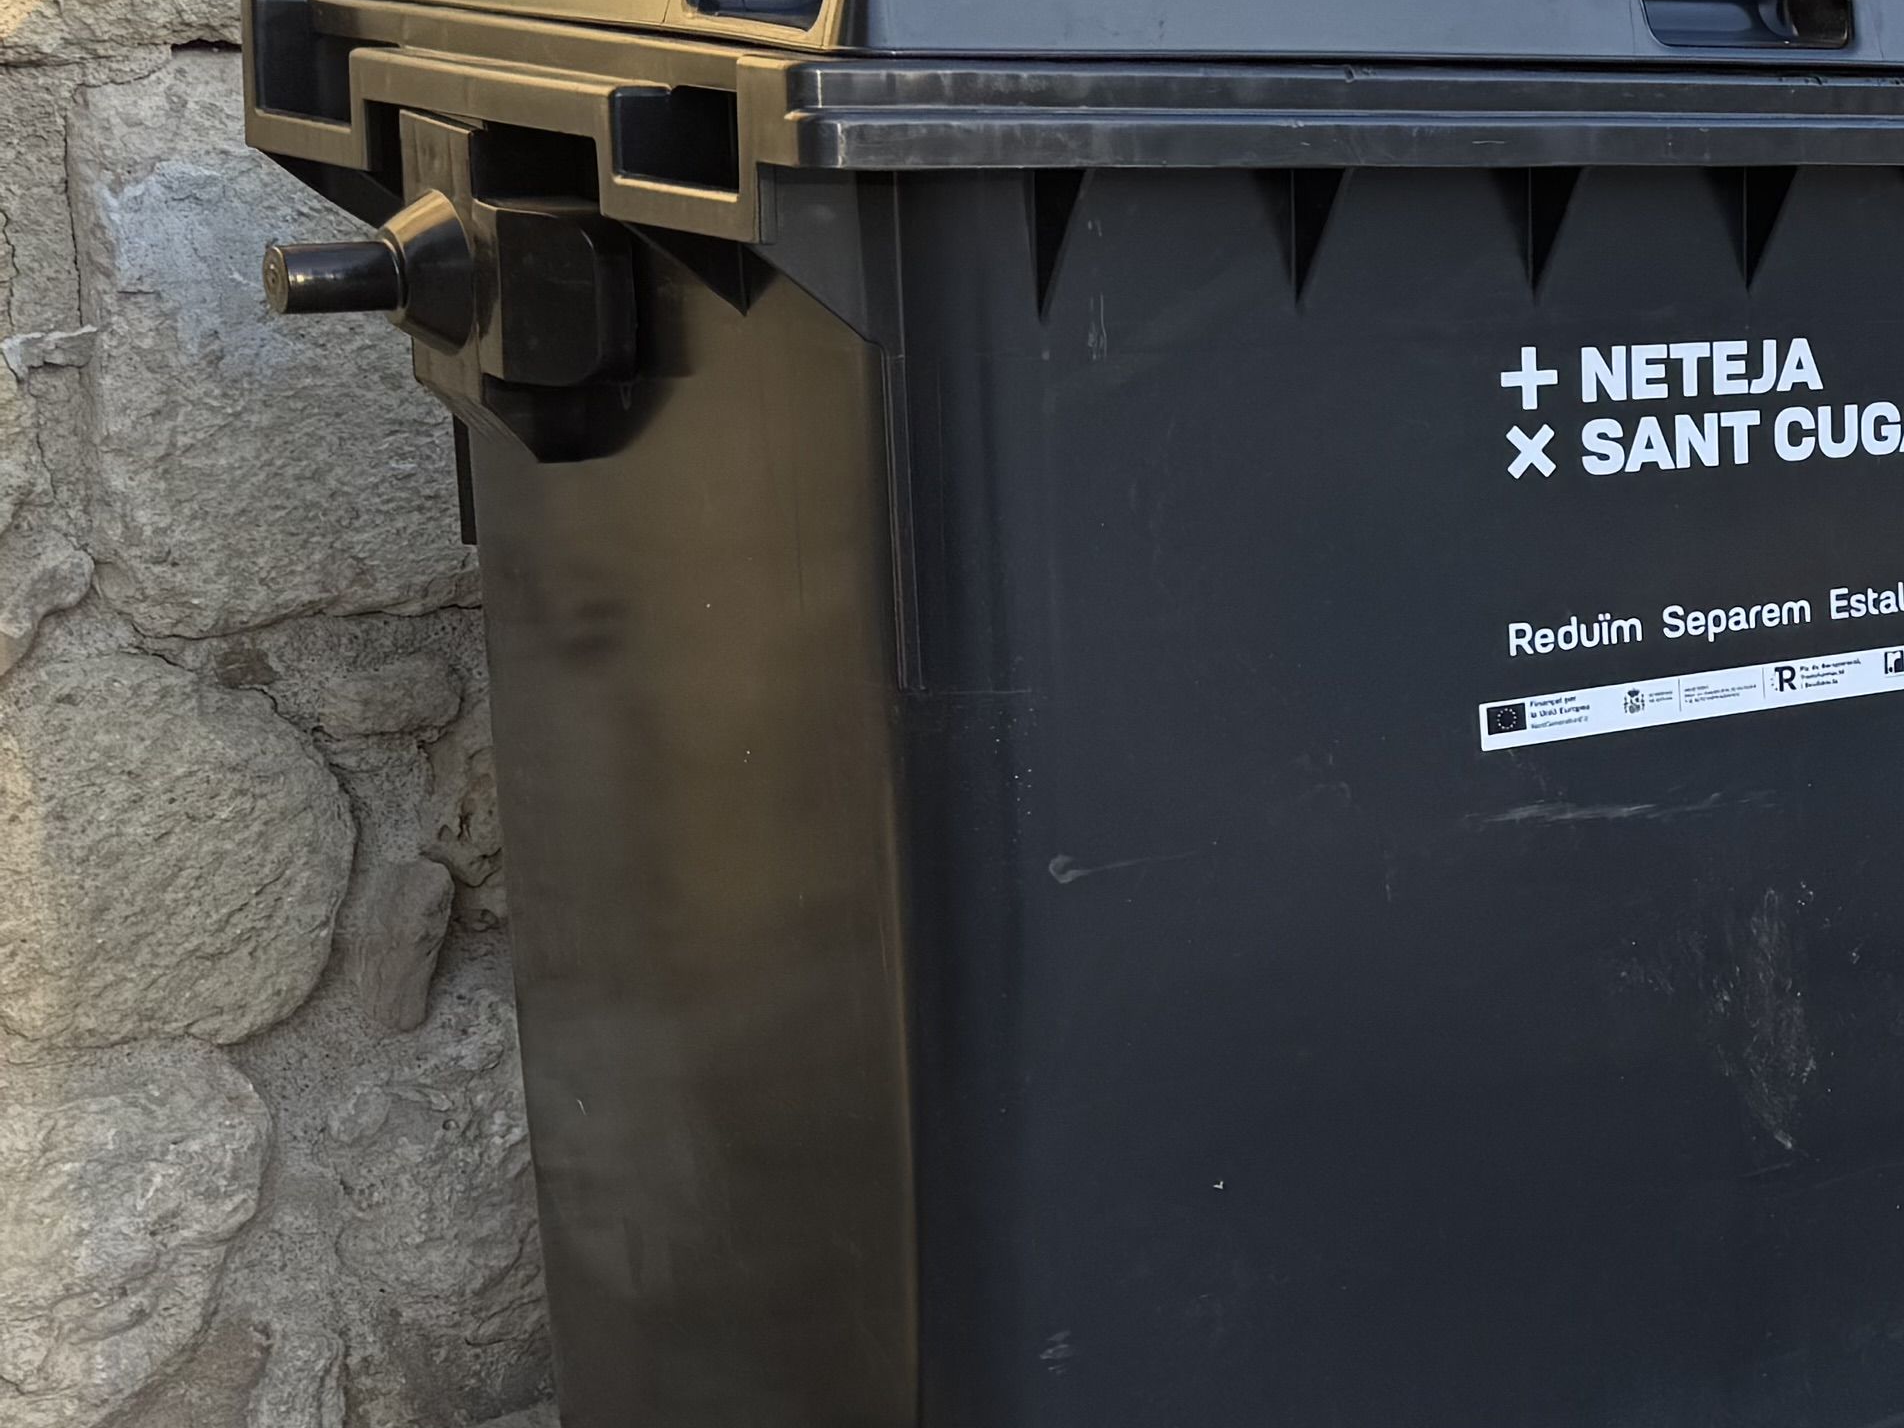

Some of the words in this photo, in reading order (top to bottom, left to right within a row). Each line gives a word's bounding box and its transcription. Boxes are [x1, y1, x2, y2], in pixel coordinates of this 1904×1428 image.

[1581, 337, 1824, 403] NETEJA
[1581, 409, 1761, 476] SANT
[1508, 612, 1643, 657] Reduïm
[1662, 599, 1811, 643] Separem
